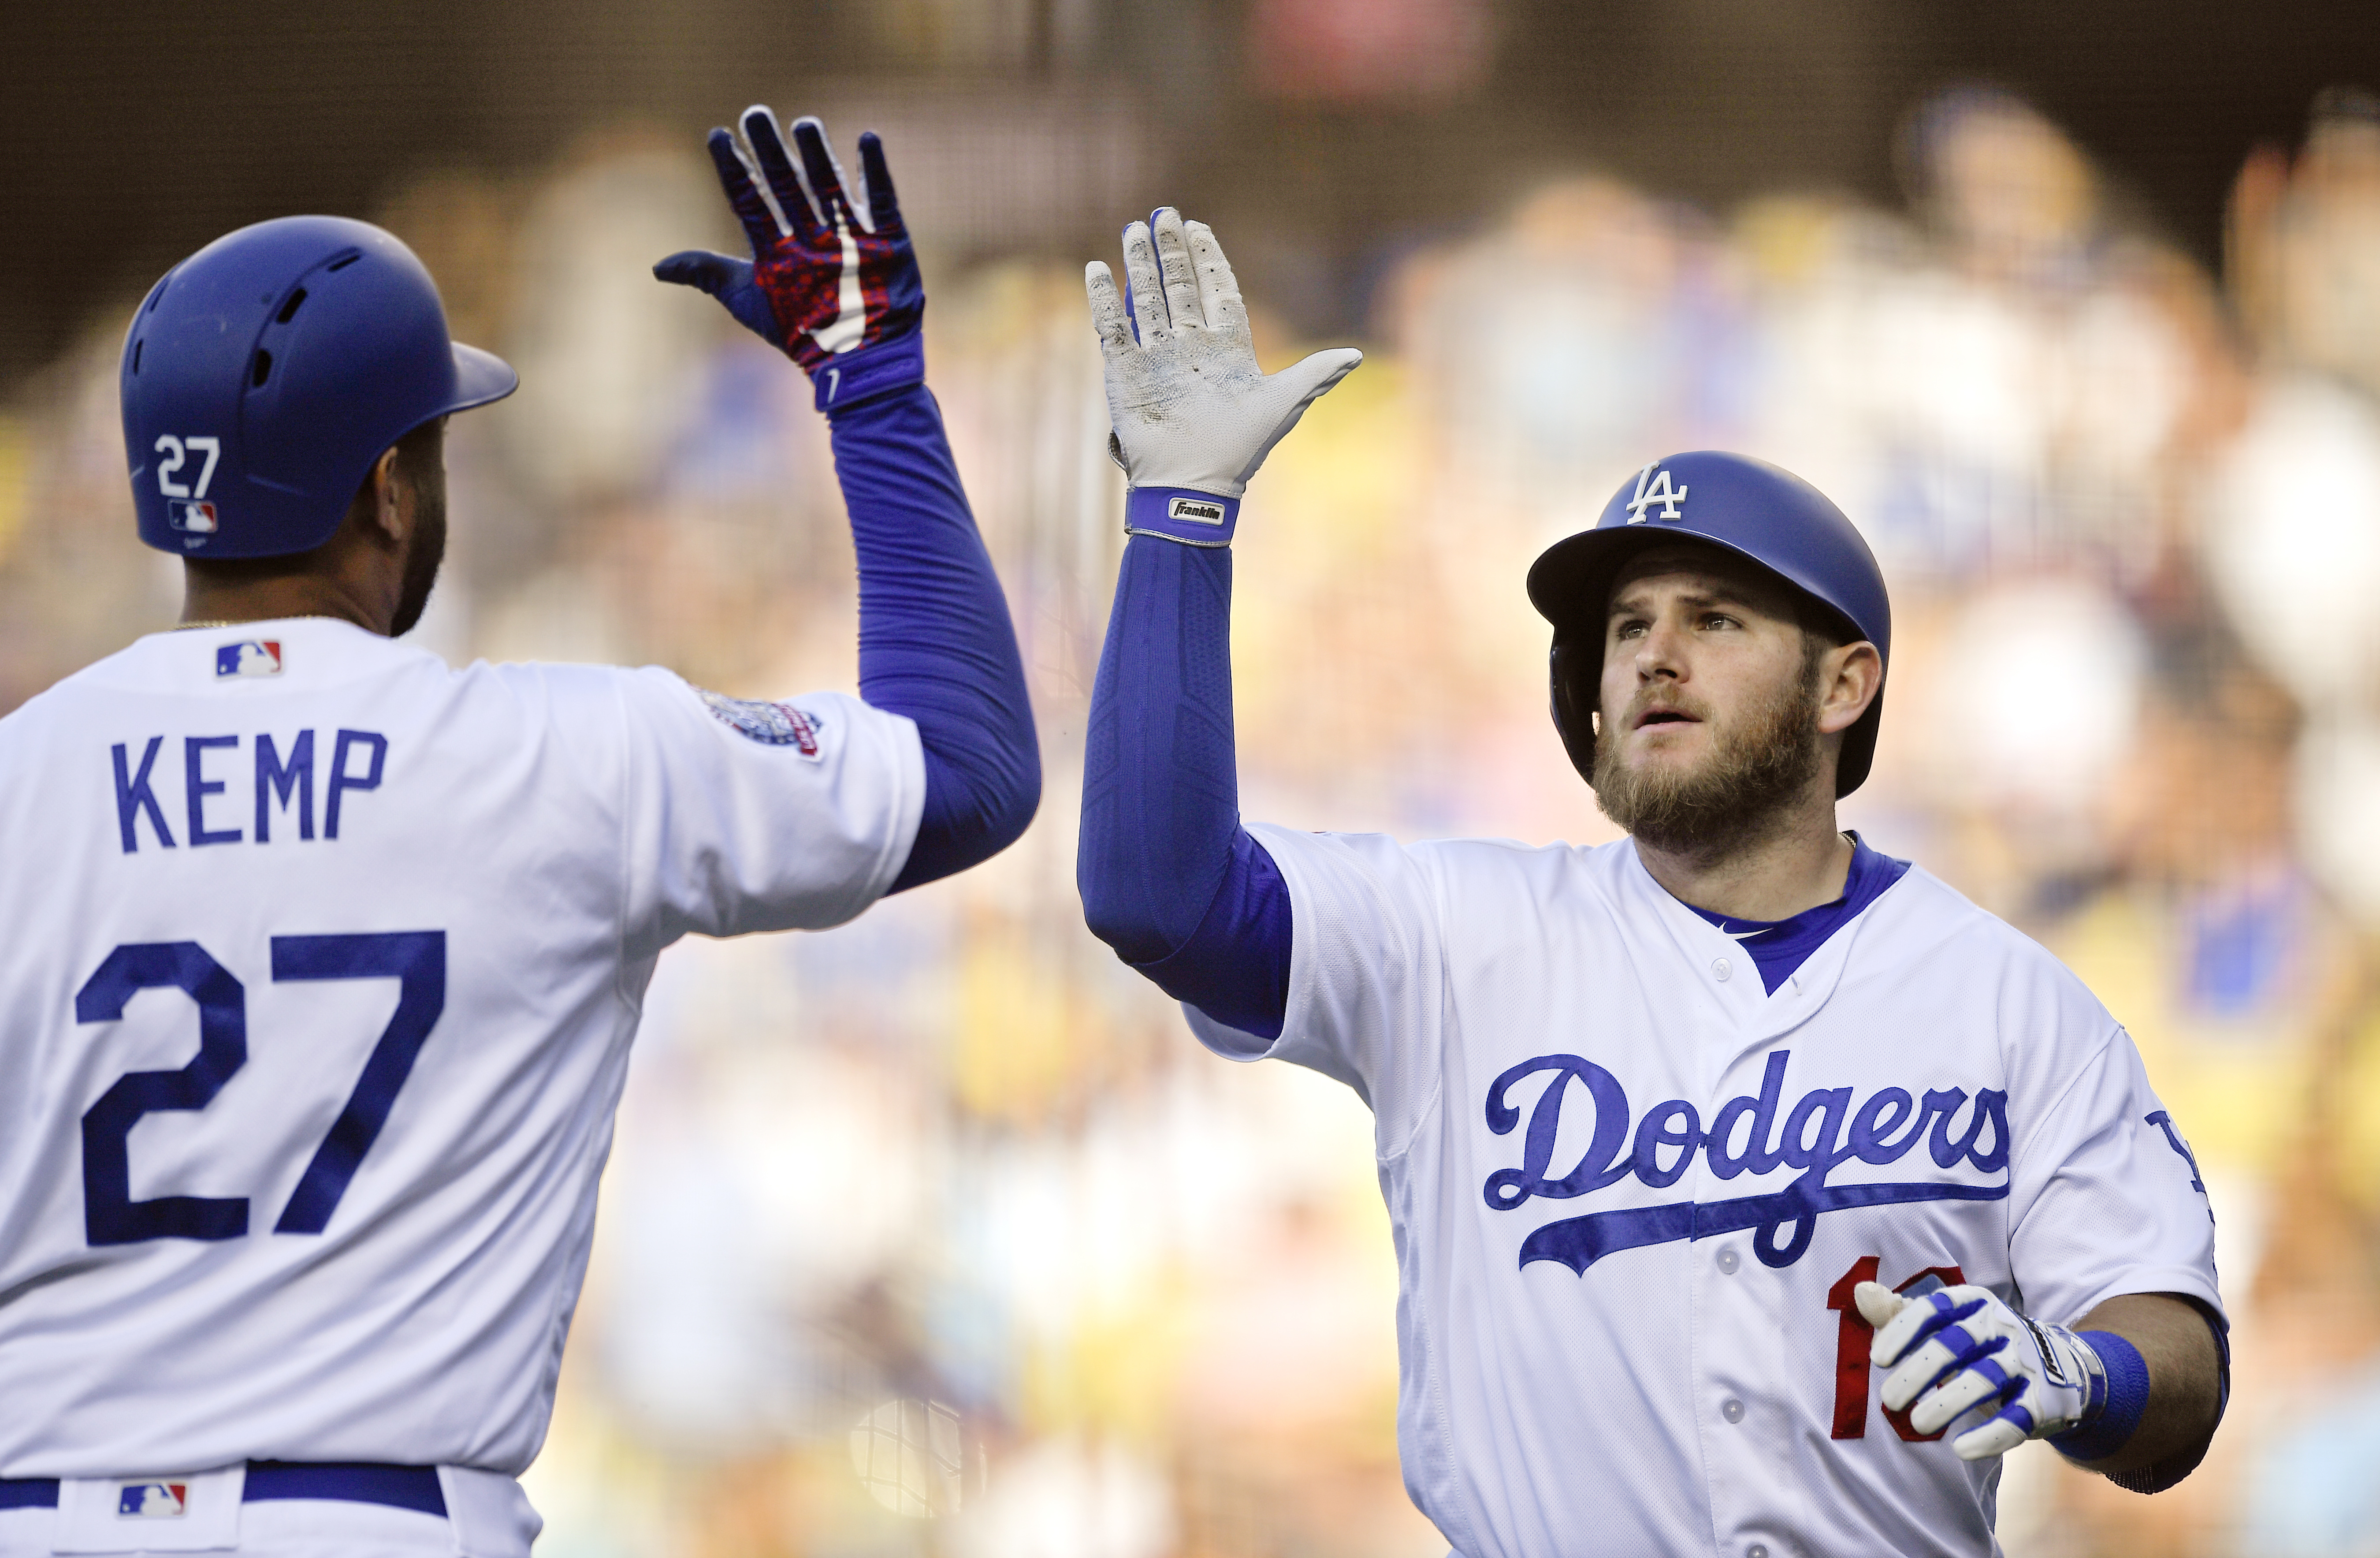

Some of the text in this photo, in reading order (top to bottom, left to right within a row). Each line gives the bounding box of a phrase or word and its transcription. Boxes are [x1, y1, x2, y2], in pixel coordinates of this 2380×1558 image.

[155, 434, 220, 499] 27
[1625, 461, 1688, 525] LA
[111, 729, 387, 854] KEMP
[75, 930, 446, 1247] 27
[1484, 1050, 2009, 1270] Dodgers
